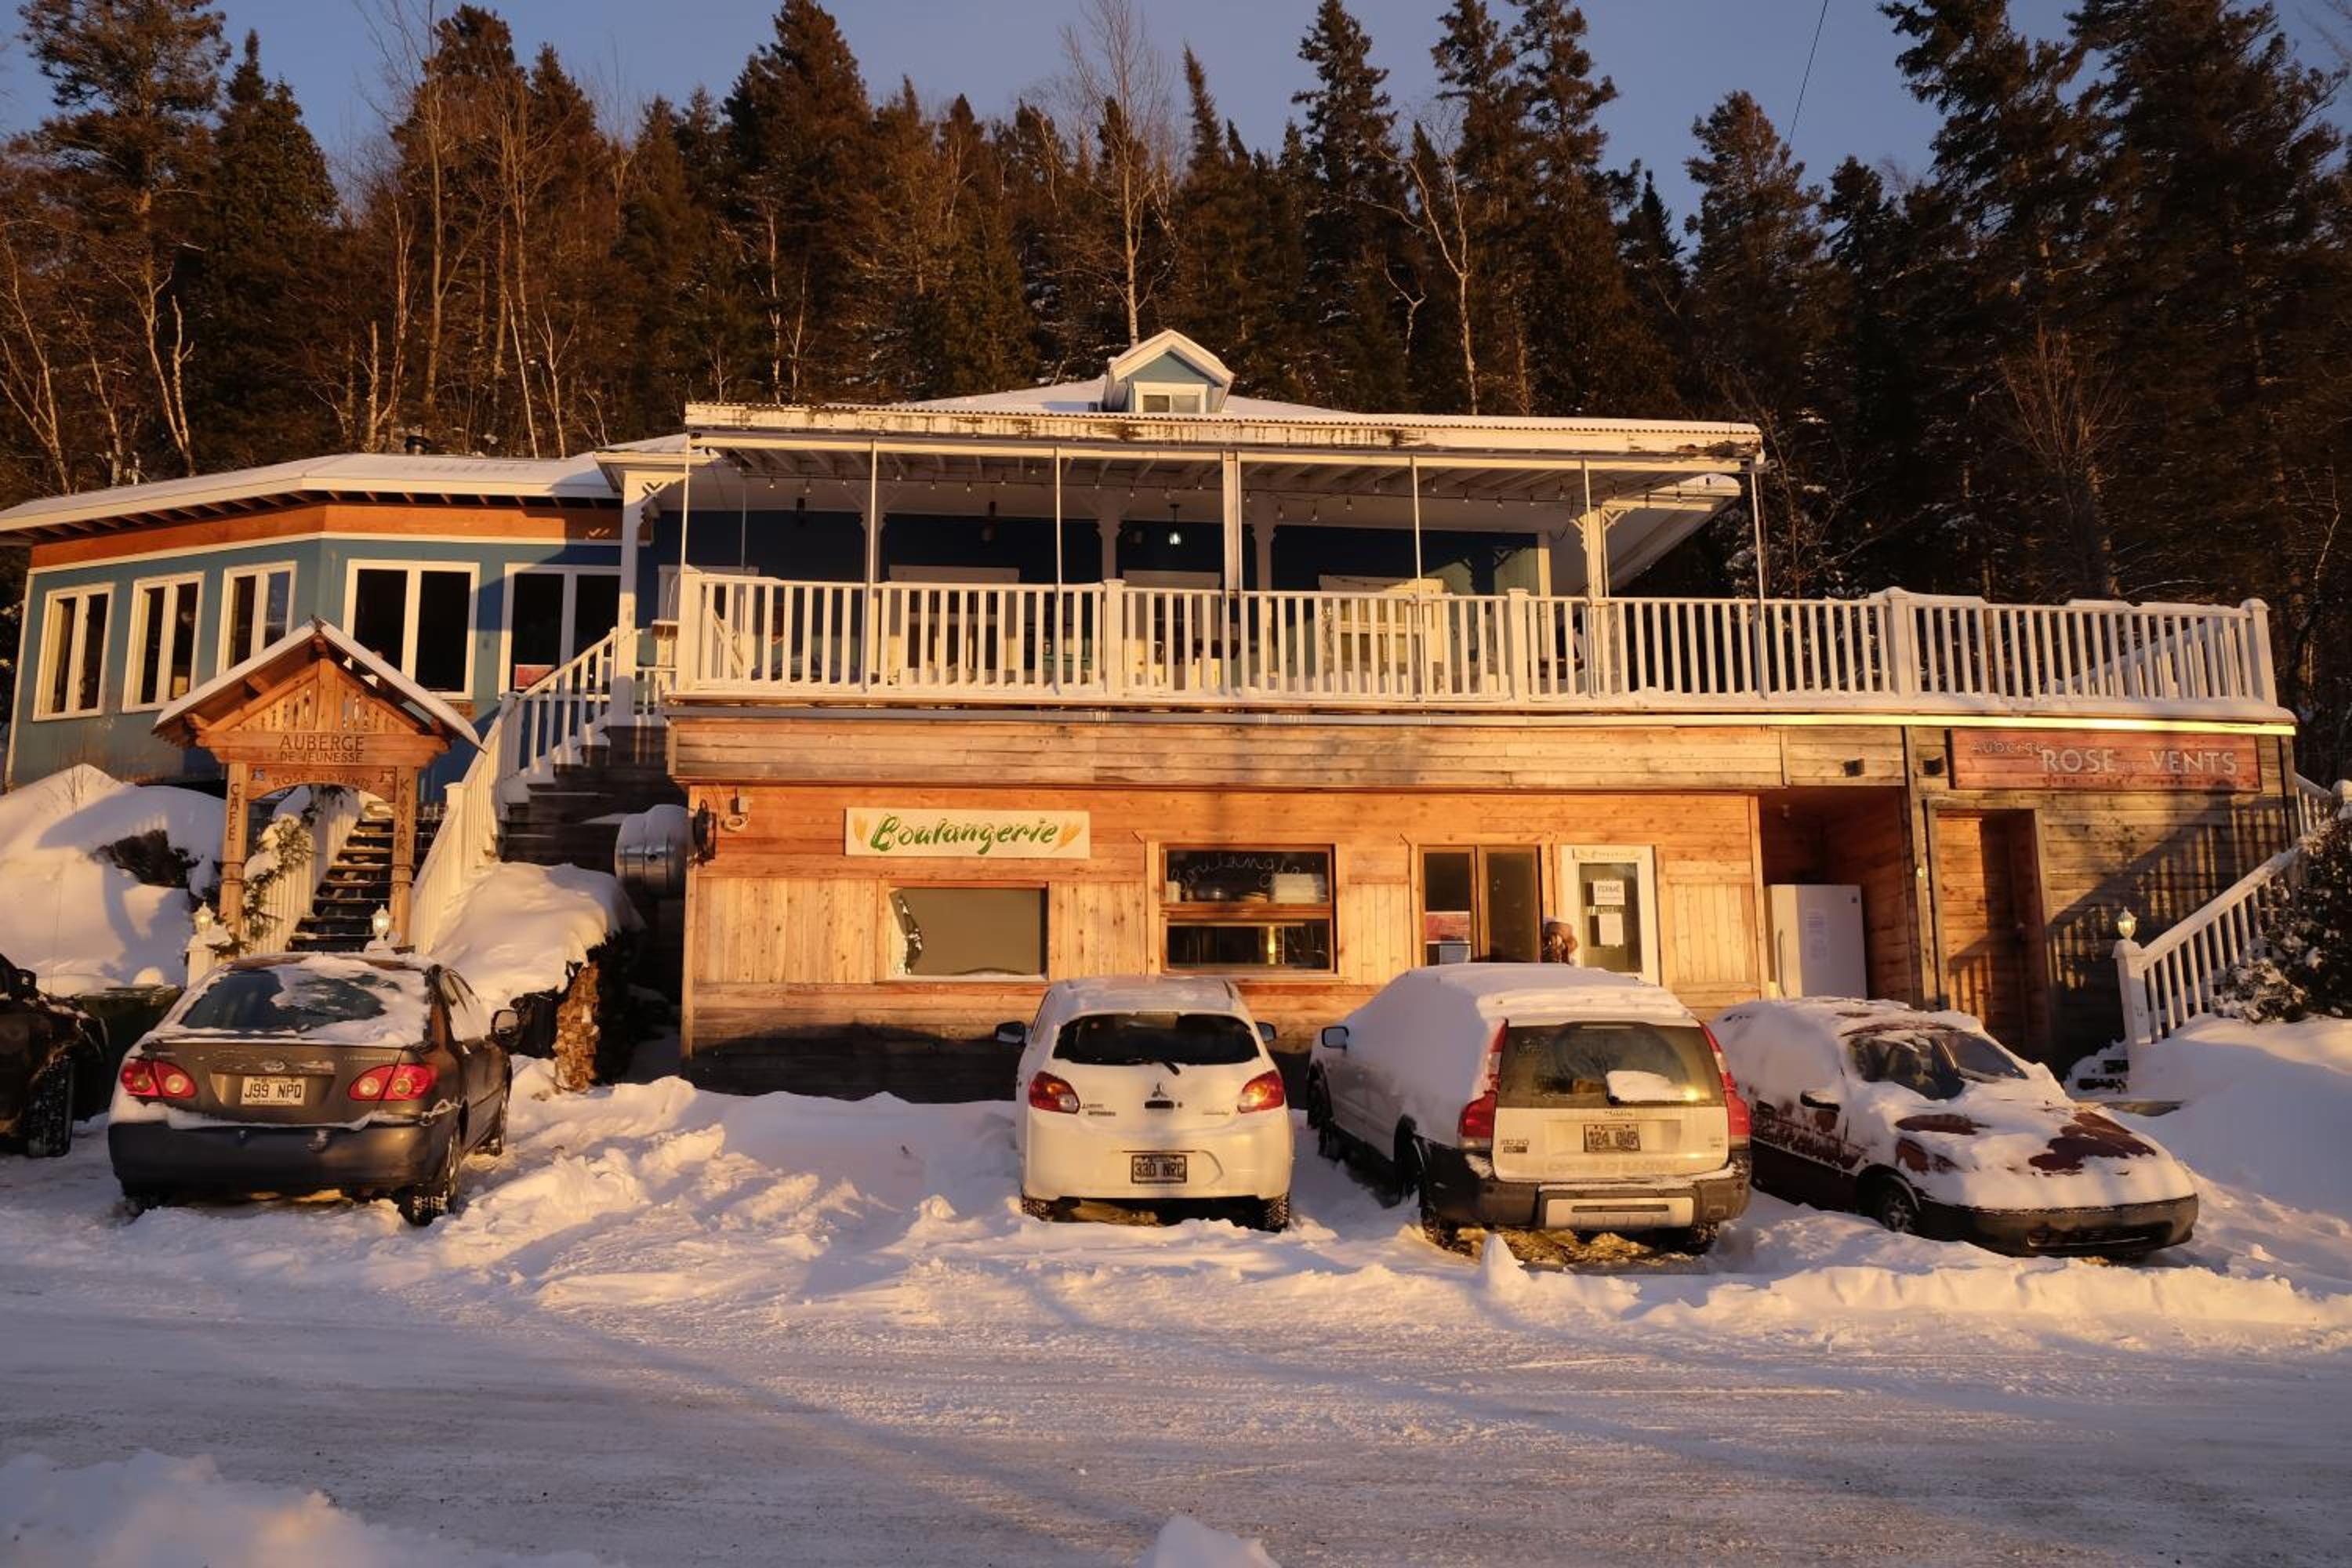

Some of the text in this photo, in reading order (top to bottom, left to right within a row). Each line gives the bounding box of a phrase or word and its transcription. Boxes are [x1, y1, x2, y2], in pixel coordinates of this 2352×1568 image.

[279, 734, 365, 752] AUBERGE
[279, 751, 364, 764] DE JEUNESSE
[2042, 749, 2117, 774] ROSE
[2147, 750, 2238, 776] VENTS
[870, 813, 1058, 855] Boulangerie
[244, 1083, 269, 1098] J99
